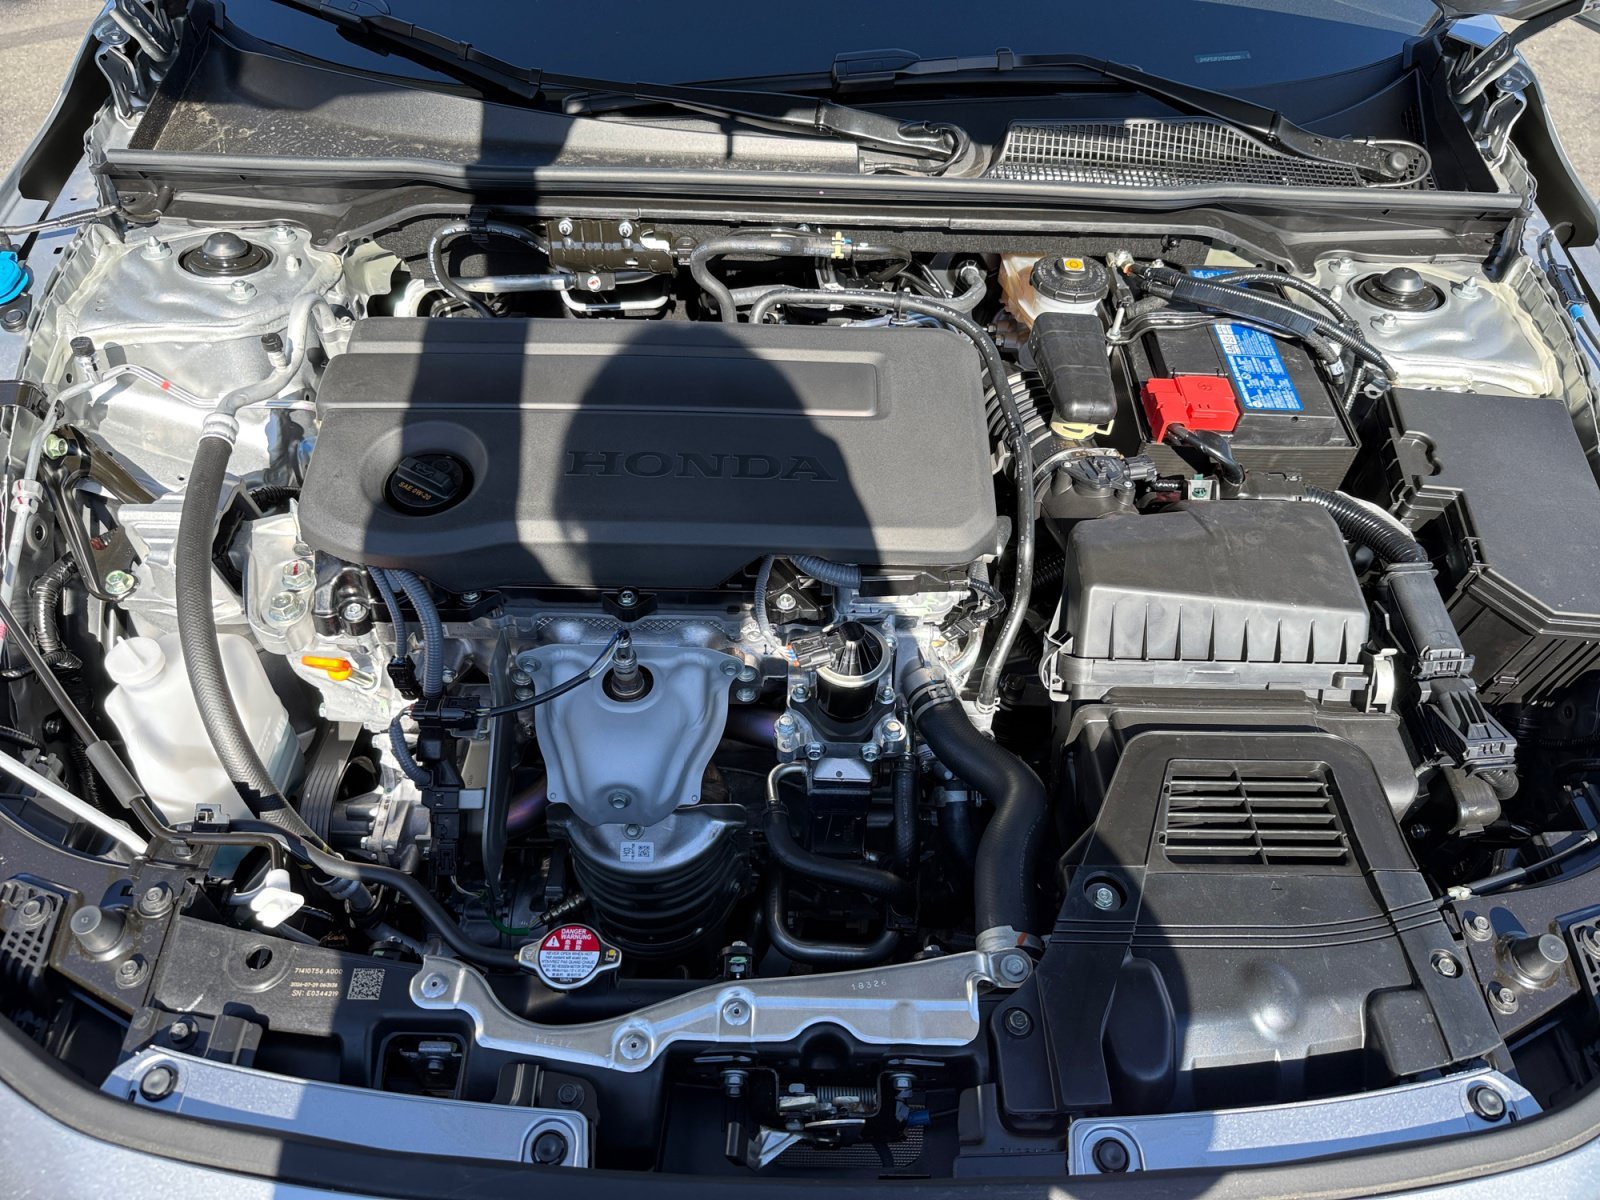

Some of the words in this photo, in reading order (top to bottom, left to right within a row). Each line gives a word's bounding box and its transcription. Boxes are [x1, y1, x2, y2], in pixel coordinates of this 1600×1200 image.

[564, 450, 839, 482] HONDA
[399, 481, 413, 492] SAE
[851, 979, 887, 990] 18326
[291, 989, 305, 997] SN:
